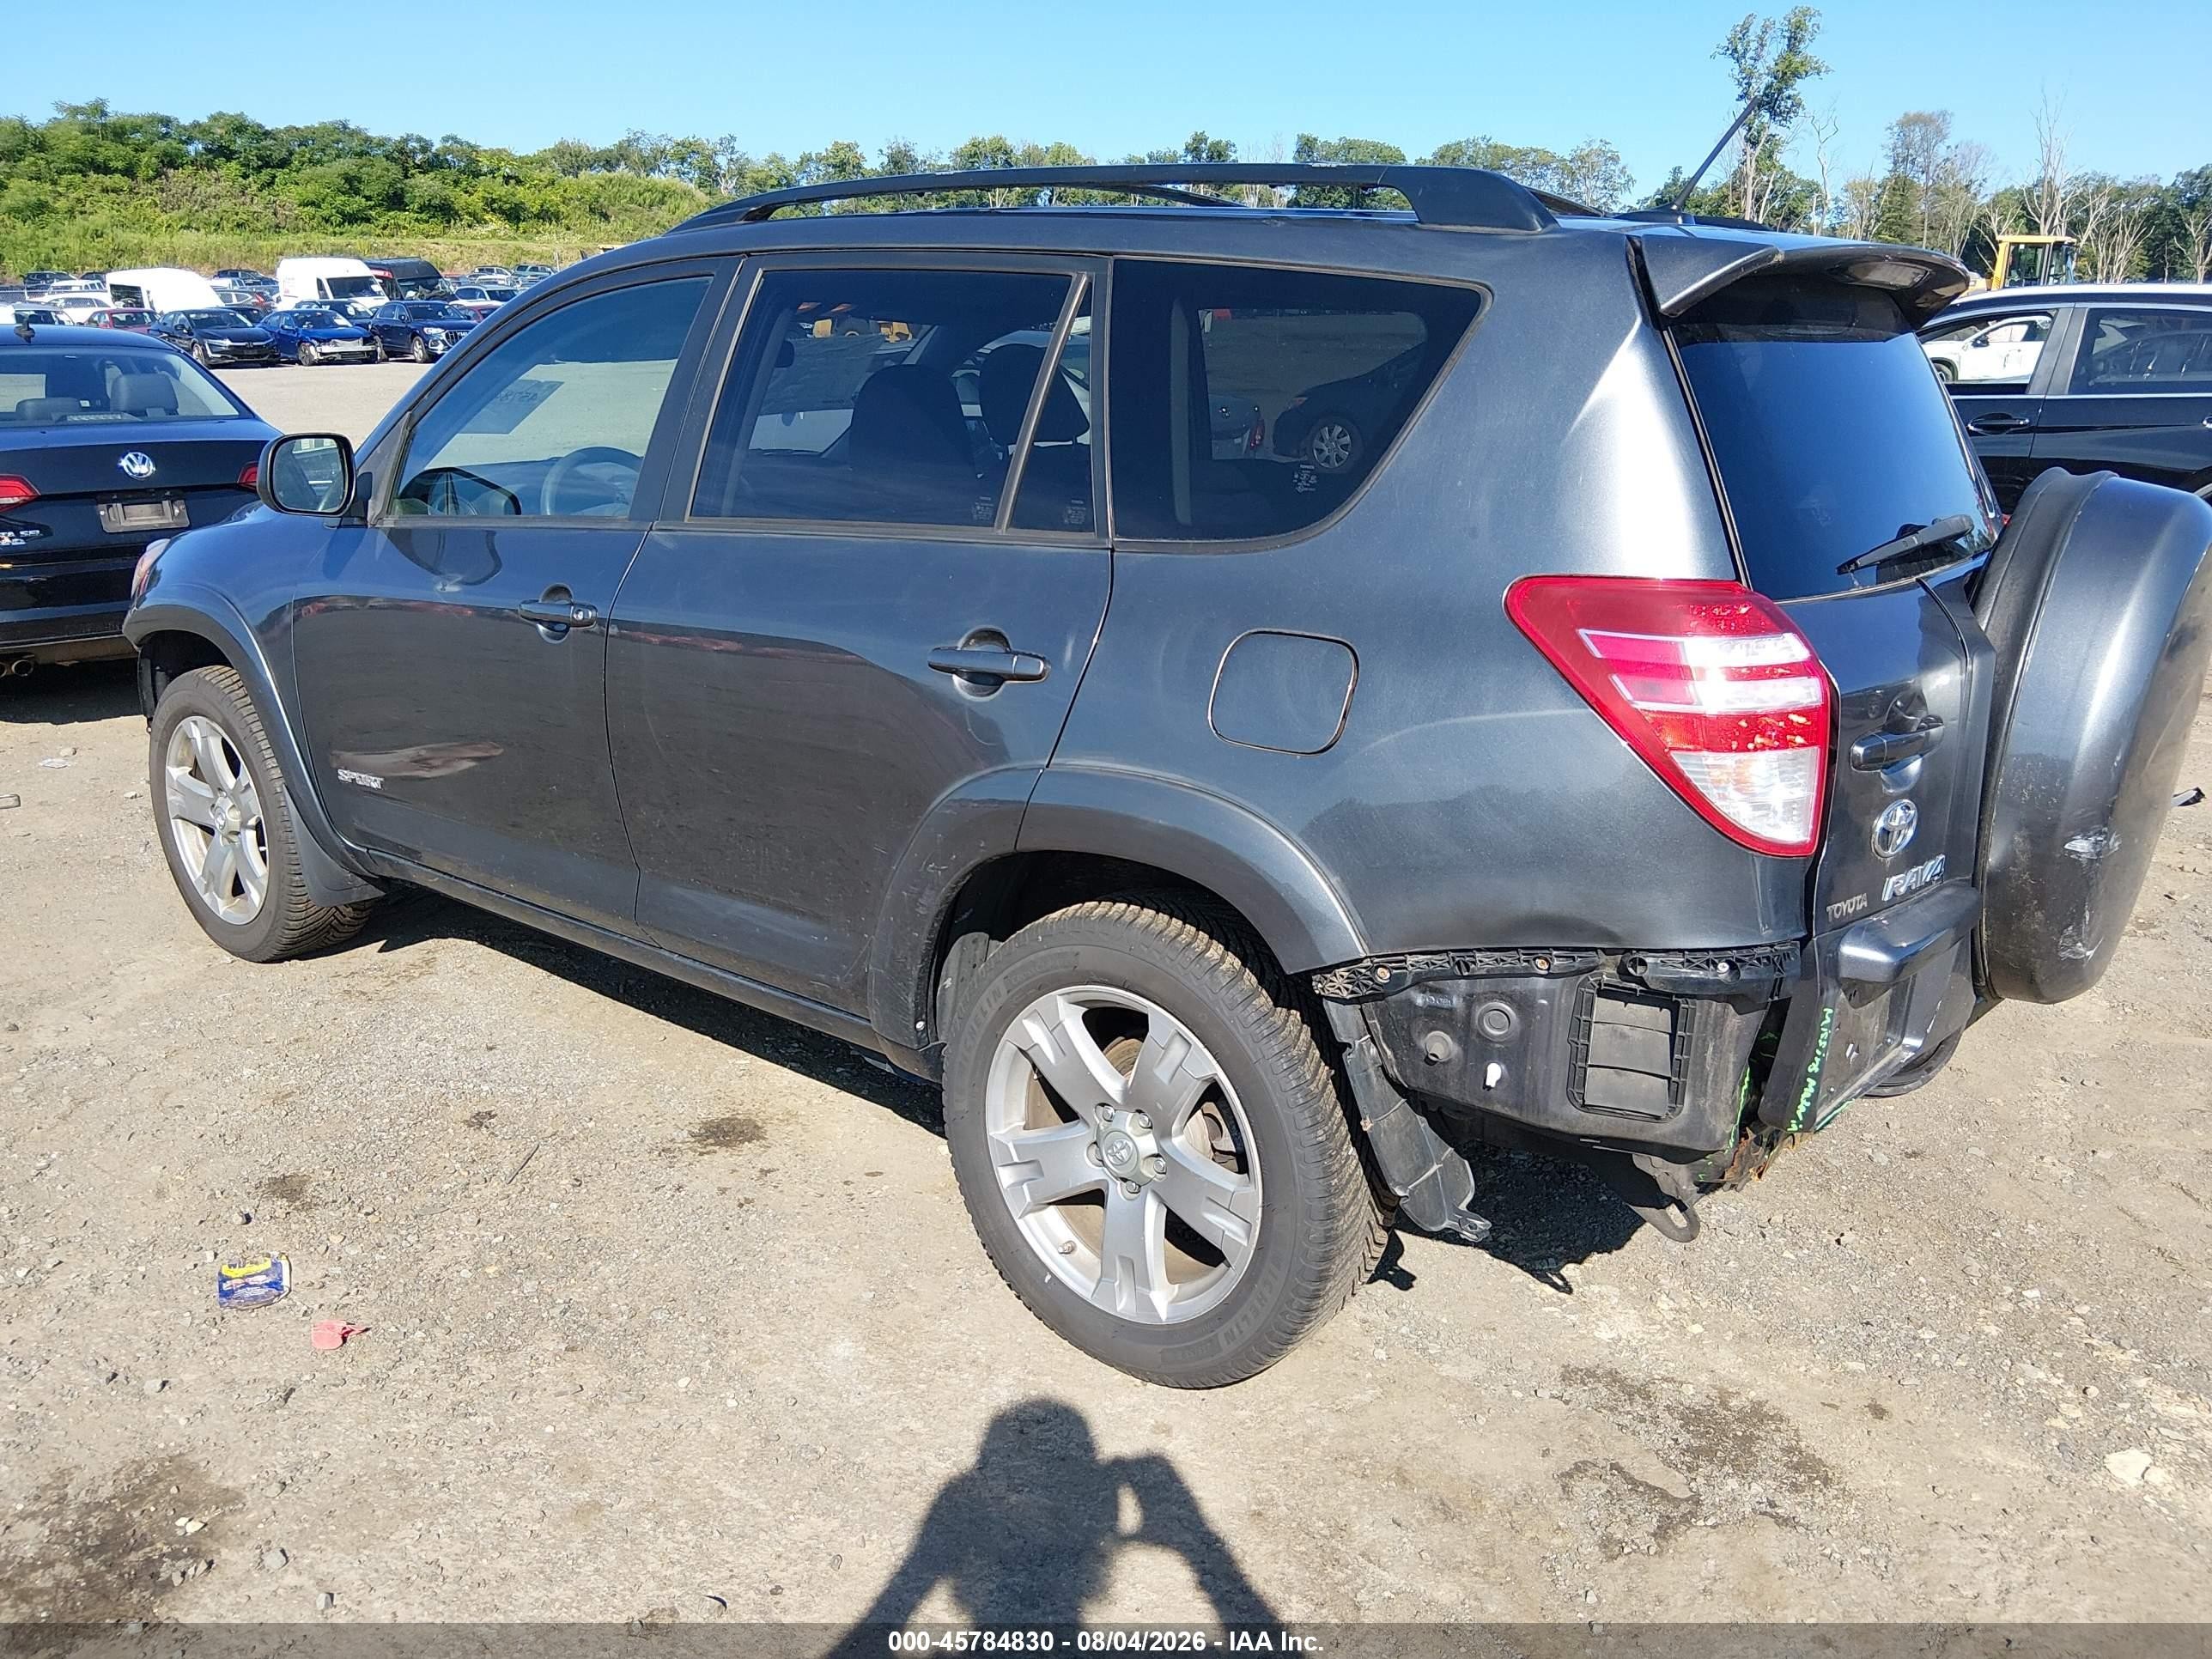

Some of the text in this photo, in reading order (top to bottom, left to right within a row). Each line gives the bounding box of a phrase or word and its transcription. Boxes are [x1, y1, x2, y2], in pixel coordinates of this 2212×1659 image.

[337, 769, 385, 789] SPORT
[1881, 854, 1946, 902] RAV4
[1826, 893, 1868, 923] TOYOTA
